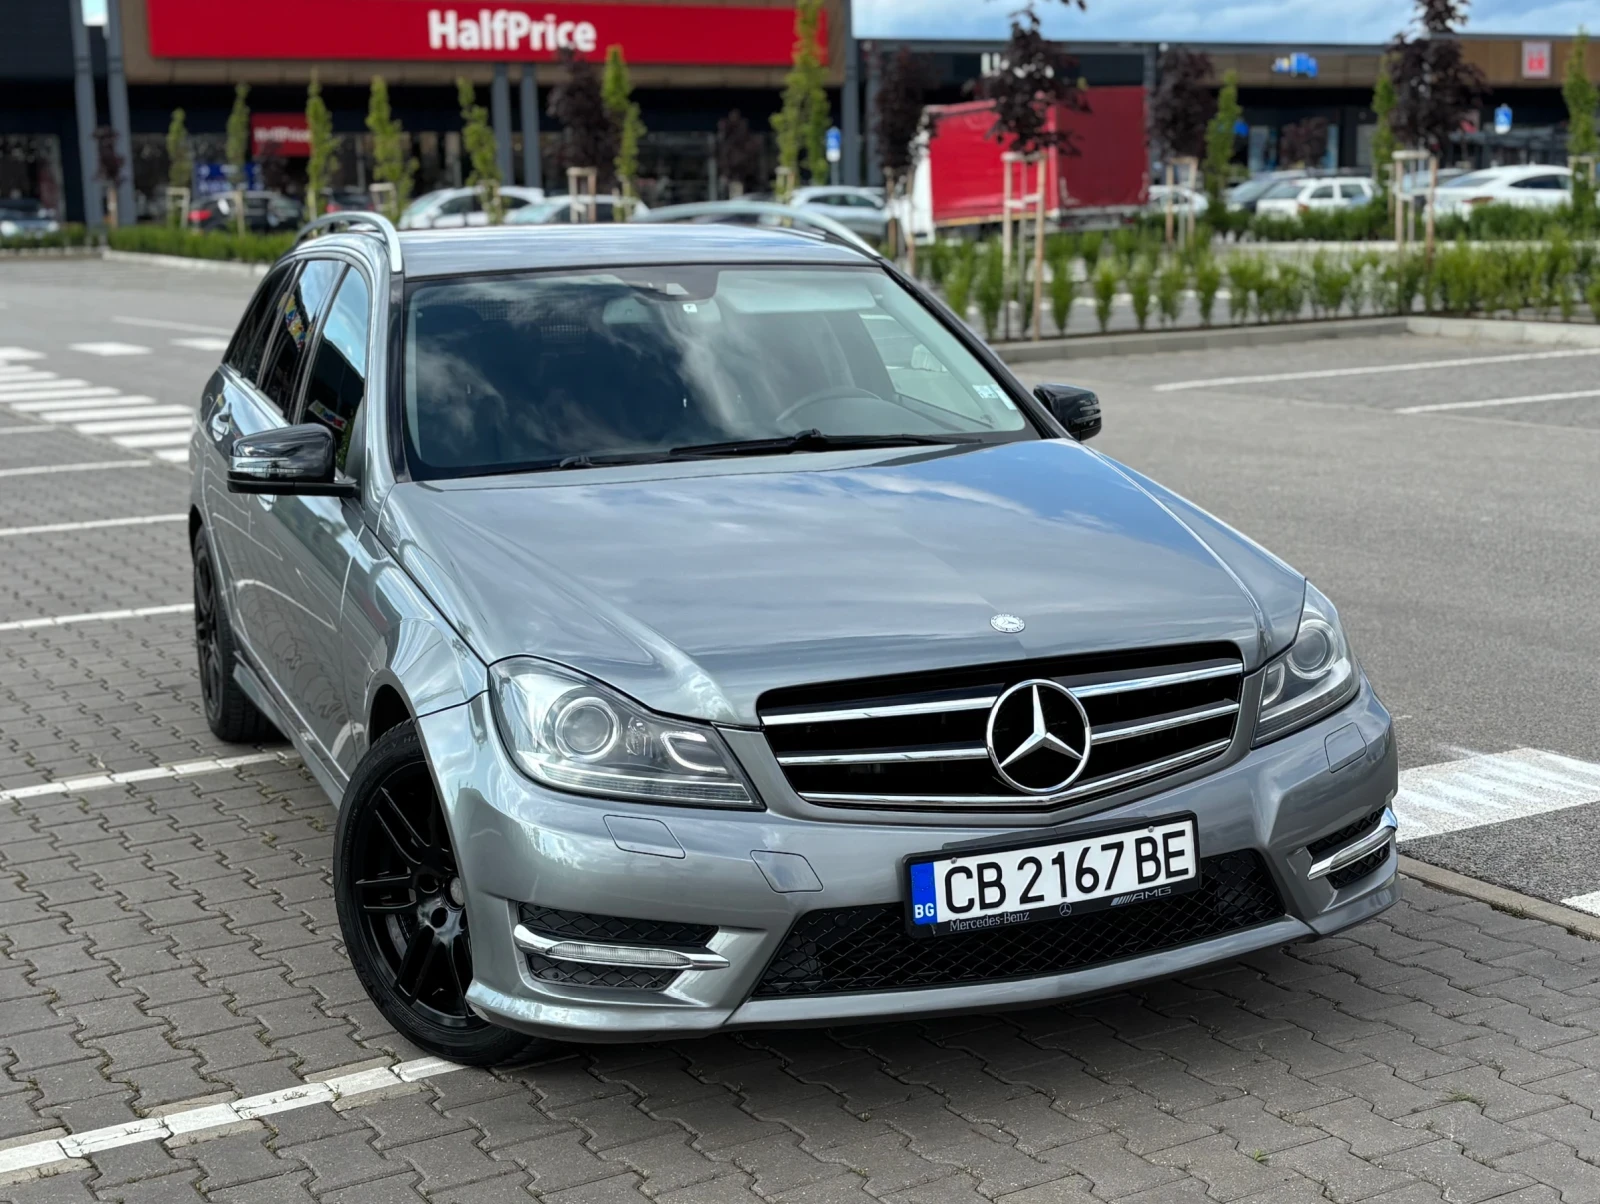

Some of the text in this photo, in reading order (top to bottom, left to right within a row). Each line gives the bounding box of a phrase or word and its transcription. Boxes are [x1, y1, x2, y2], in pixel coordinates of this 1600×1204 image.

[428, 9, 597, 51] HalfPrice
[945, 830, 1188, 913] CB 2167 BE
[915, 903, 934, 918] BG
[950, 911, 1030, 932] Mercedes-Benz
